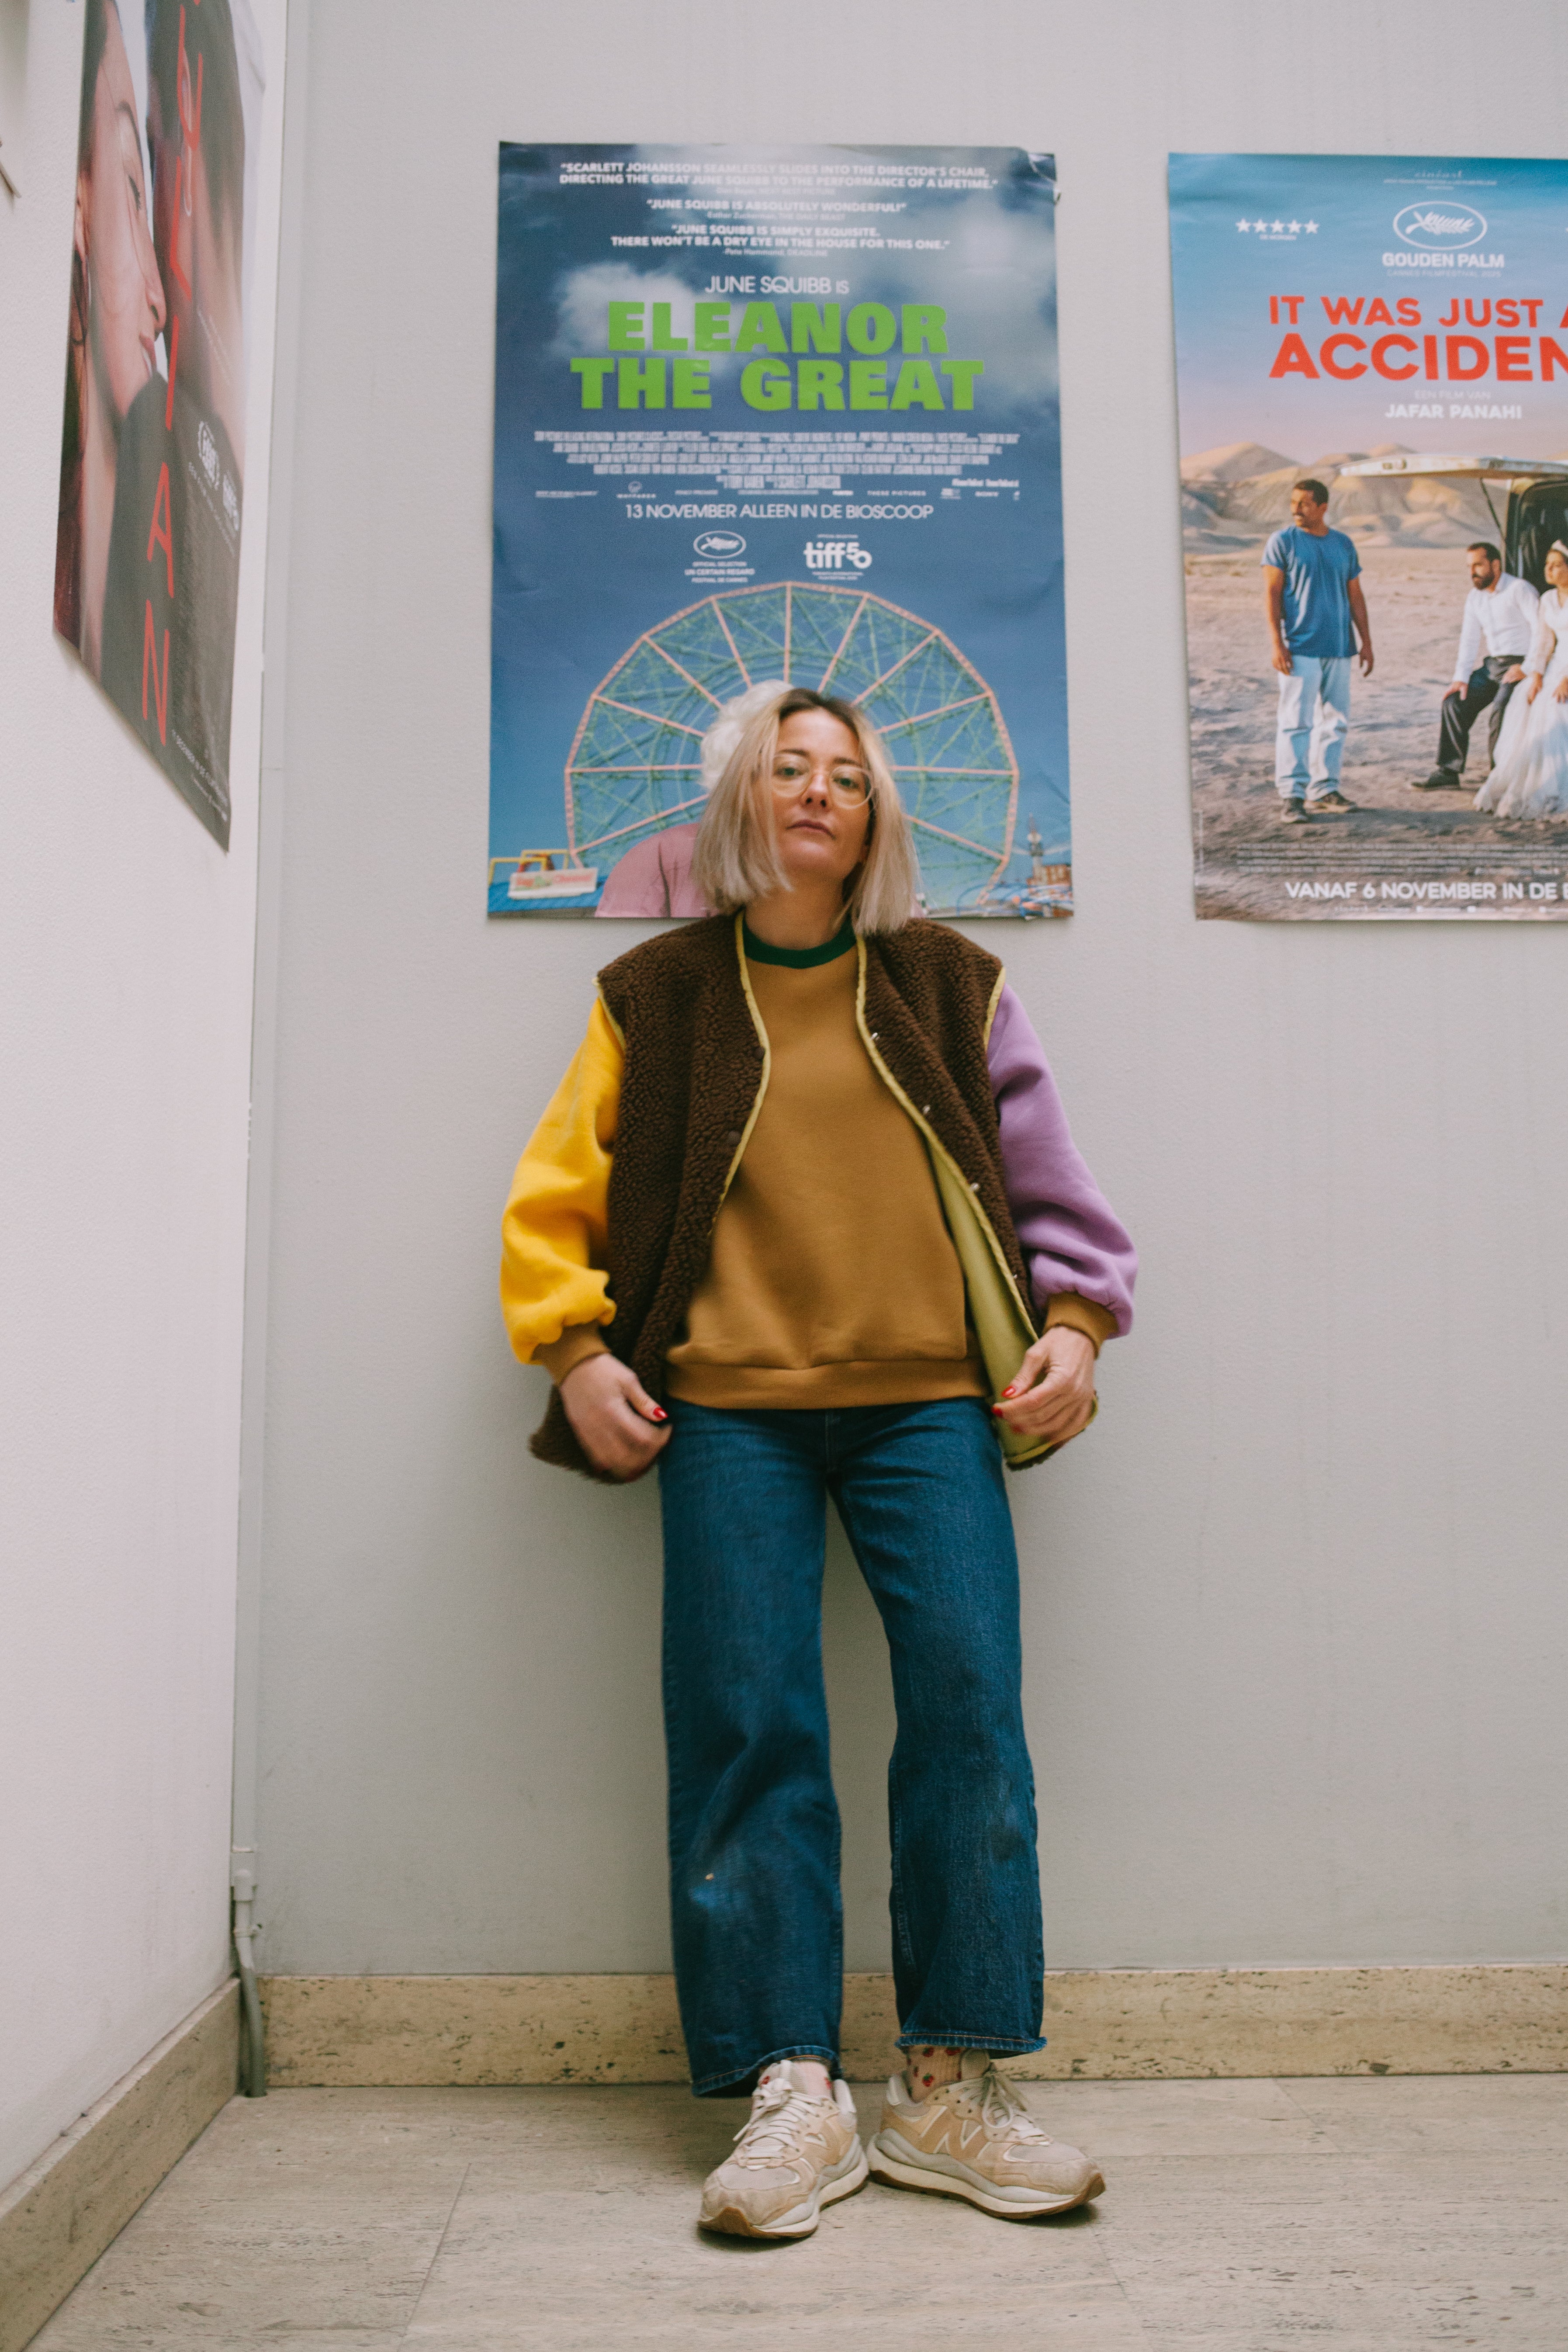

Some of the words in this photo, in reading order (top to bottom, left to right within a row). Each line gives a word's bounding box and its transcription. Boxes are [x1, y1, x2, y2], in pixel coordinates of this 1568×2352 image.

[626, 163, 700, 173] JOHANSSON
[703, 164, 776, 174] SEAMLESSLY
[778, 164, 818, 174] SLIDES
[820, 165, 850, 174] INTO
[852, 165, 875, 175] THE
[559, 174, 624, 184] DIRECTING
[626, 174, 649, 184] THE
[651, 175, 689, 184] GREAT
[692, 175, 722, 185] JUNE
[725, 176, 770, 186] SQUIBB
[772, 176, 789, 186] TO
[790, 176, 813, 186] THE
[816, 177, 905, 187] PERFORMANCE
[907, 178, 924, 188] OF
[926, 178, 936, 188] A
[684, 199, 730, 210] SQUIBB
[731, 200, 743, 210] IS
[745, 201, 819, 211] ABSOLUTELY
[709, 224, 755, 235] SQUIBB
[756, 225, 768, 235] IS
[770, 225, 813, 236] SIMPLY
[814, 226, 880, 237] EXQUISITE.
[610, 236, 649, 246] THERE
[695, 236, 710, 246] BE
[711, 236, 722, 246] A
[723, 236, 748, 246] DRY
[750, 237, 773, 247] EYE
[775, 237, 789, 247] IN
[790, 237, 813, 248] THE
[816, 238, 857, 248] HOUSE
[859, 239, 885, 249] FOR
[886, 239, 913, 249] THIS
[1382, 252, 1455, 267] GOUDEN
[1457, 253, 1505, 268] PALM
[706, 275, 755, 293] JUNE
[760, 275, 832, 295] SQUIBB
[836, 280, 850, 294] IS
[1270, 295, 1305, 325] IT
[1320, 296, 1422, 326] WAS
[1438, 298, 1544, 328] JUST
[608, 301, 949, 355] ELEANOR
[570, 357, 712, 409] THE
[740, 357, 984, 411] GREAT
[1414, 390, 1436, 400] EEN
[1439, 390, 1464, 400] FILM
[1467, 390, 1492, 401] VAN
[1385, 403, 1444, 419] JAFAR
[1449, 404, 1522, 419] PANAHI
[626, 504, 644, 519] 13
[646, 504, 737, 519] NOVEMBER
[740, 504, 798, 519] ALLEEN
[801, 504, 818, 519] IN
[820, 504, 842, 519] DE
[846, 504, 934, 520] BIOSCOOP
[1284, 881, 1357, 899] VANAF
[1362, 882, 1376, 899] 6
[1381, 882, 1496, 900] NOVEMBER
[1502, 882, 1524, 900] IN
[1529, 882, 1558, 900] DE
